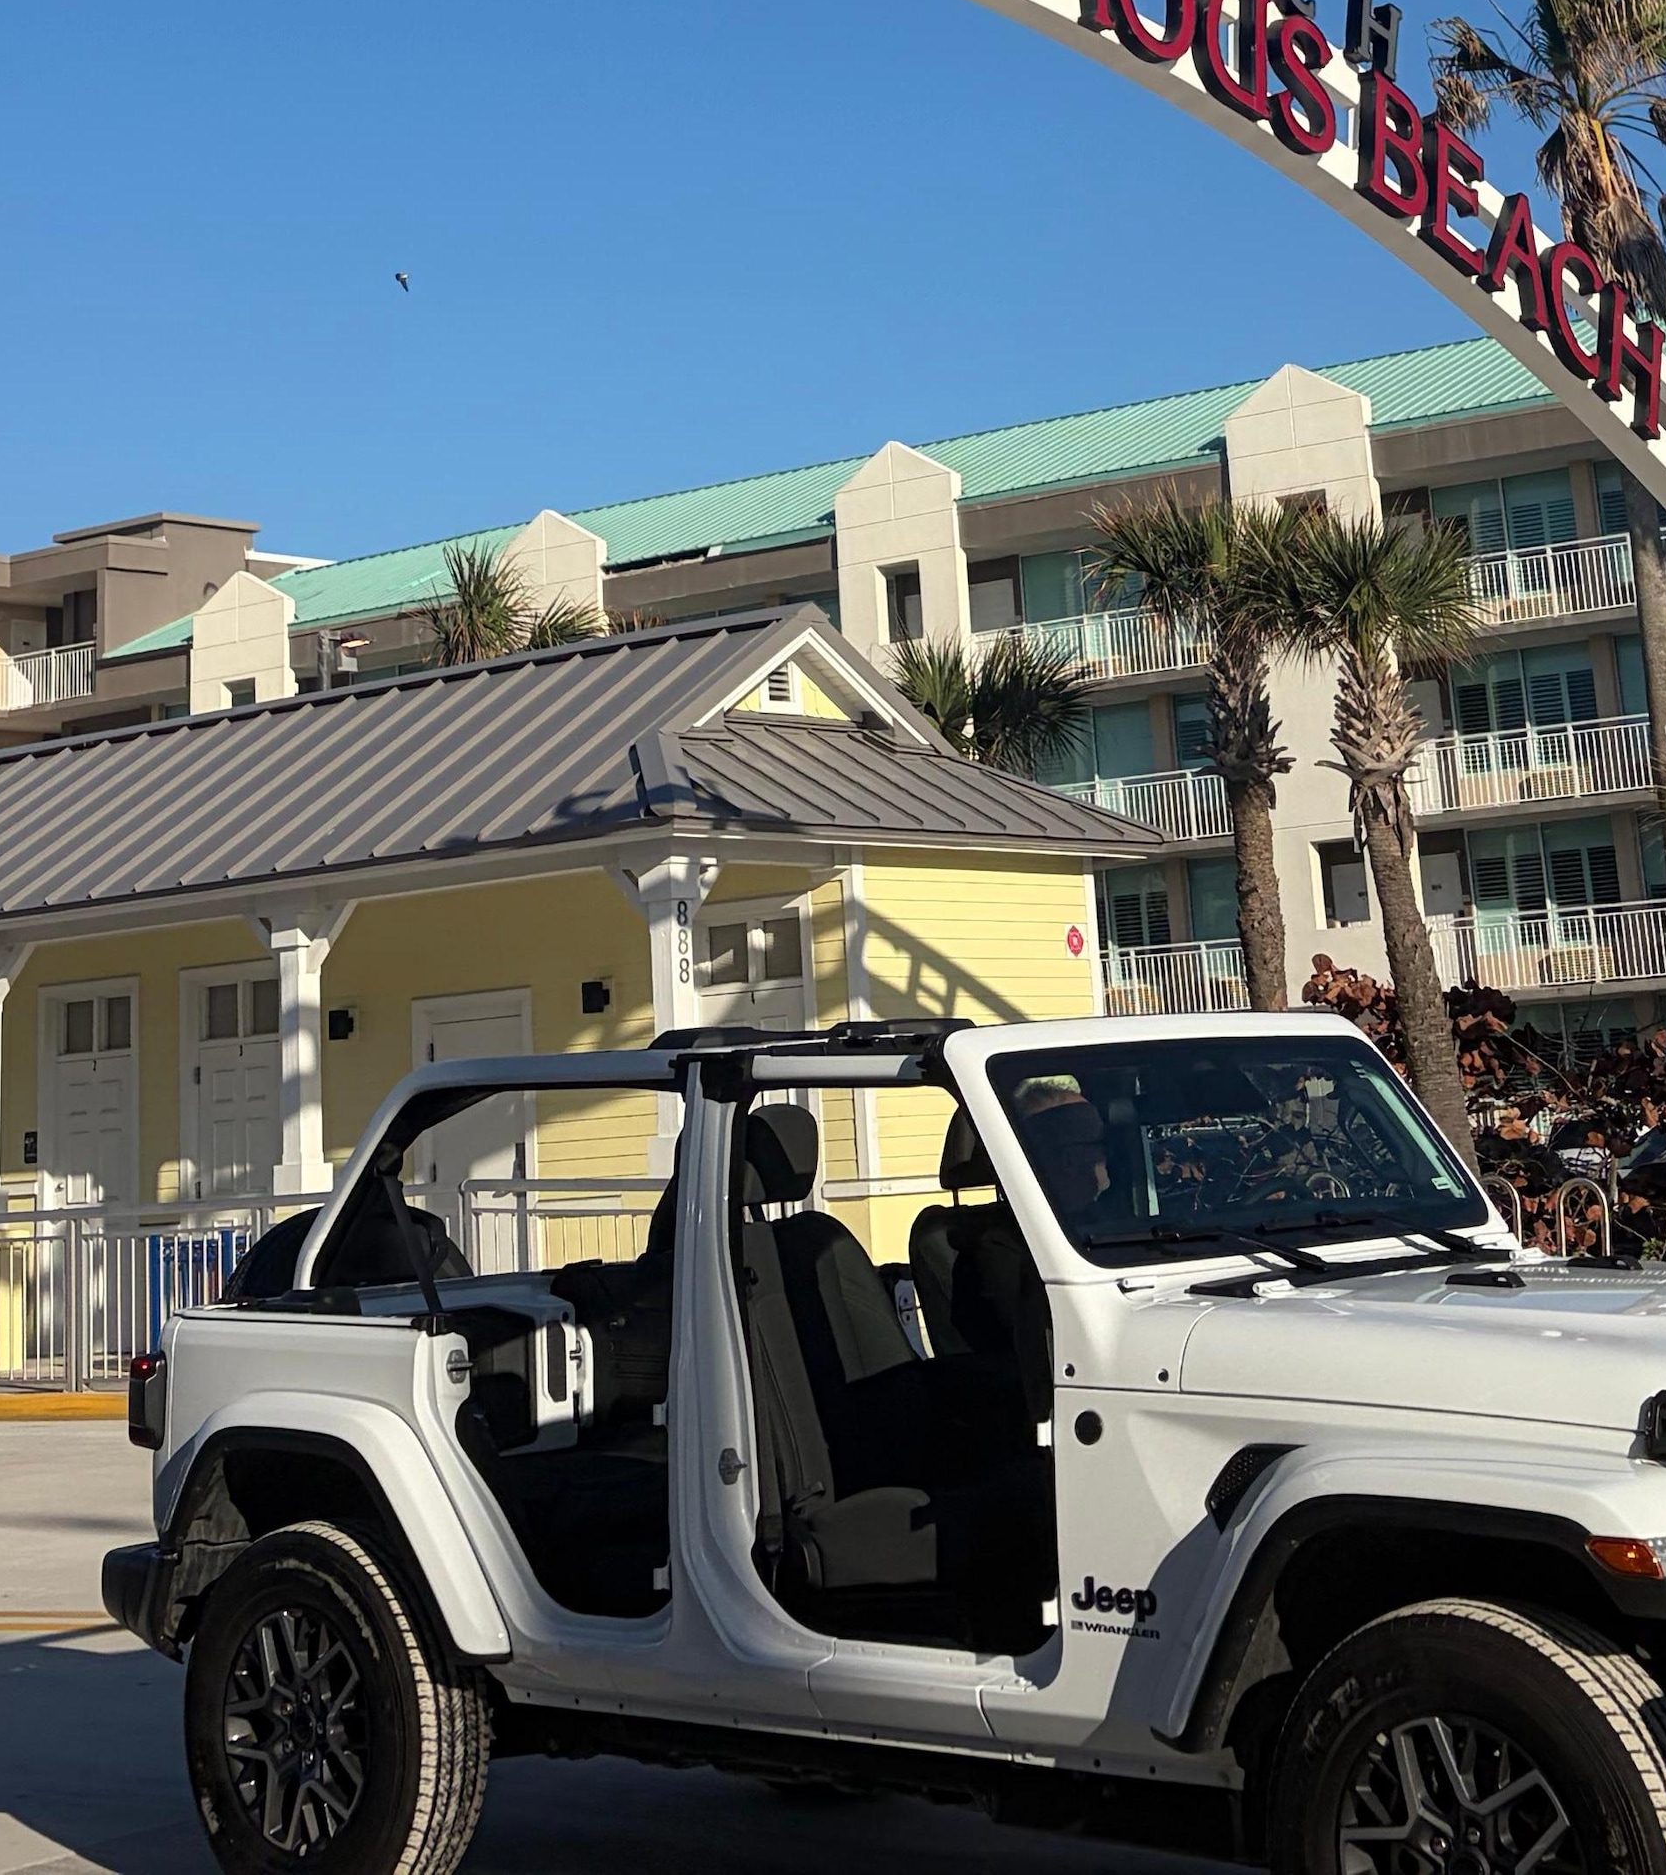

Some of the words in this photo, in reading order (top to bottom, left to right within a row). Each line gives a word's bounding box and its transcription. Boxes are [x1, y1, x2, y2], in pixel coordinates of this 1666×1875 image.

[1355, 69, 1666, 441] BEACH
[1070, 1575, 1158, 1623] Jeep
[1083, 1621, 1161, 1640] WRANGLER
